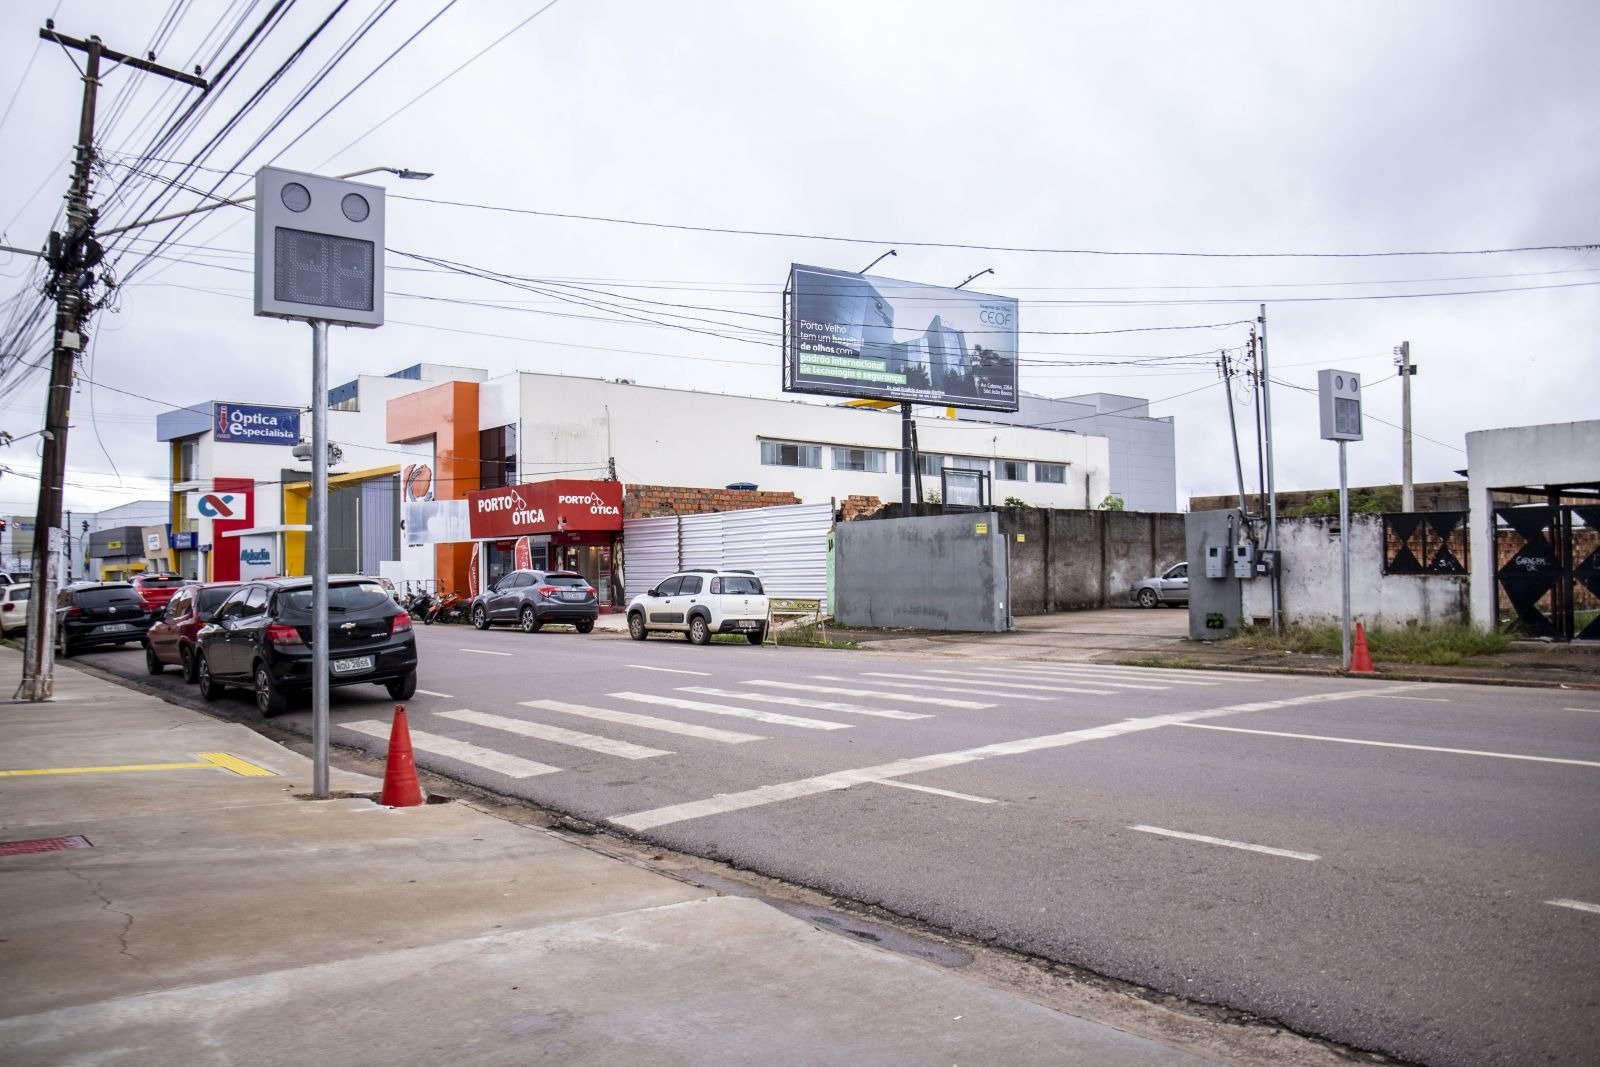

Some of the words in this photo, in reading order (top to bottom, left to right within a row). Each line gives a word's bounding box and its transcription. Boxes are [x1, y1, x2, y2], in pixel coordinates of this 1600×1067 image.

[980, 310, 1011, 326] CEOF
[800, 319, 823, 331] Porto
[825, 323, 847, 334] Velho
[800, 342, 811, 351] de
[812, 344, 835, 354] olhos
[836, 348, 853, 356] com
[832, 356, 885, 370] internacional
[813, 365, 856, 380] tecnologia
[230, 409, 278, 427] Óptica
[229, 422, 294, 438] especialista
[478, 495, 513, 513] PORTO
[558, 495, 592, 505] PORTO
[512, 507, 545, 526] ÓTICA
[590, 503, 620, 515] ÓTICA
